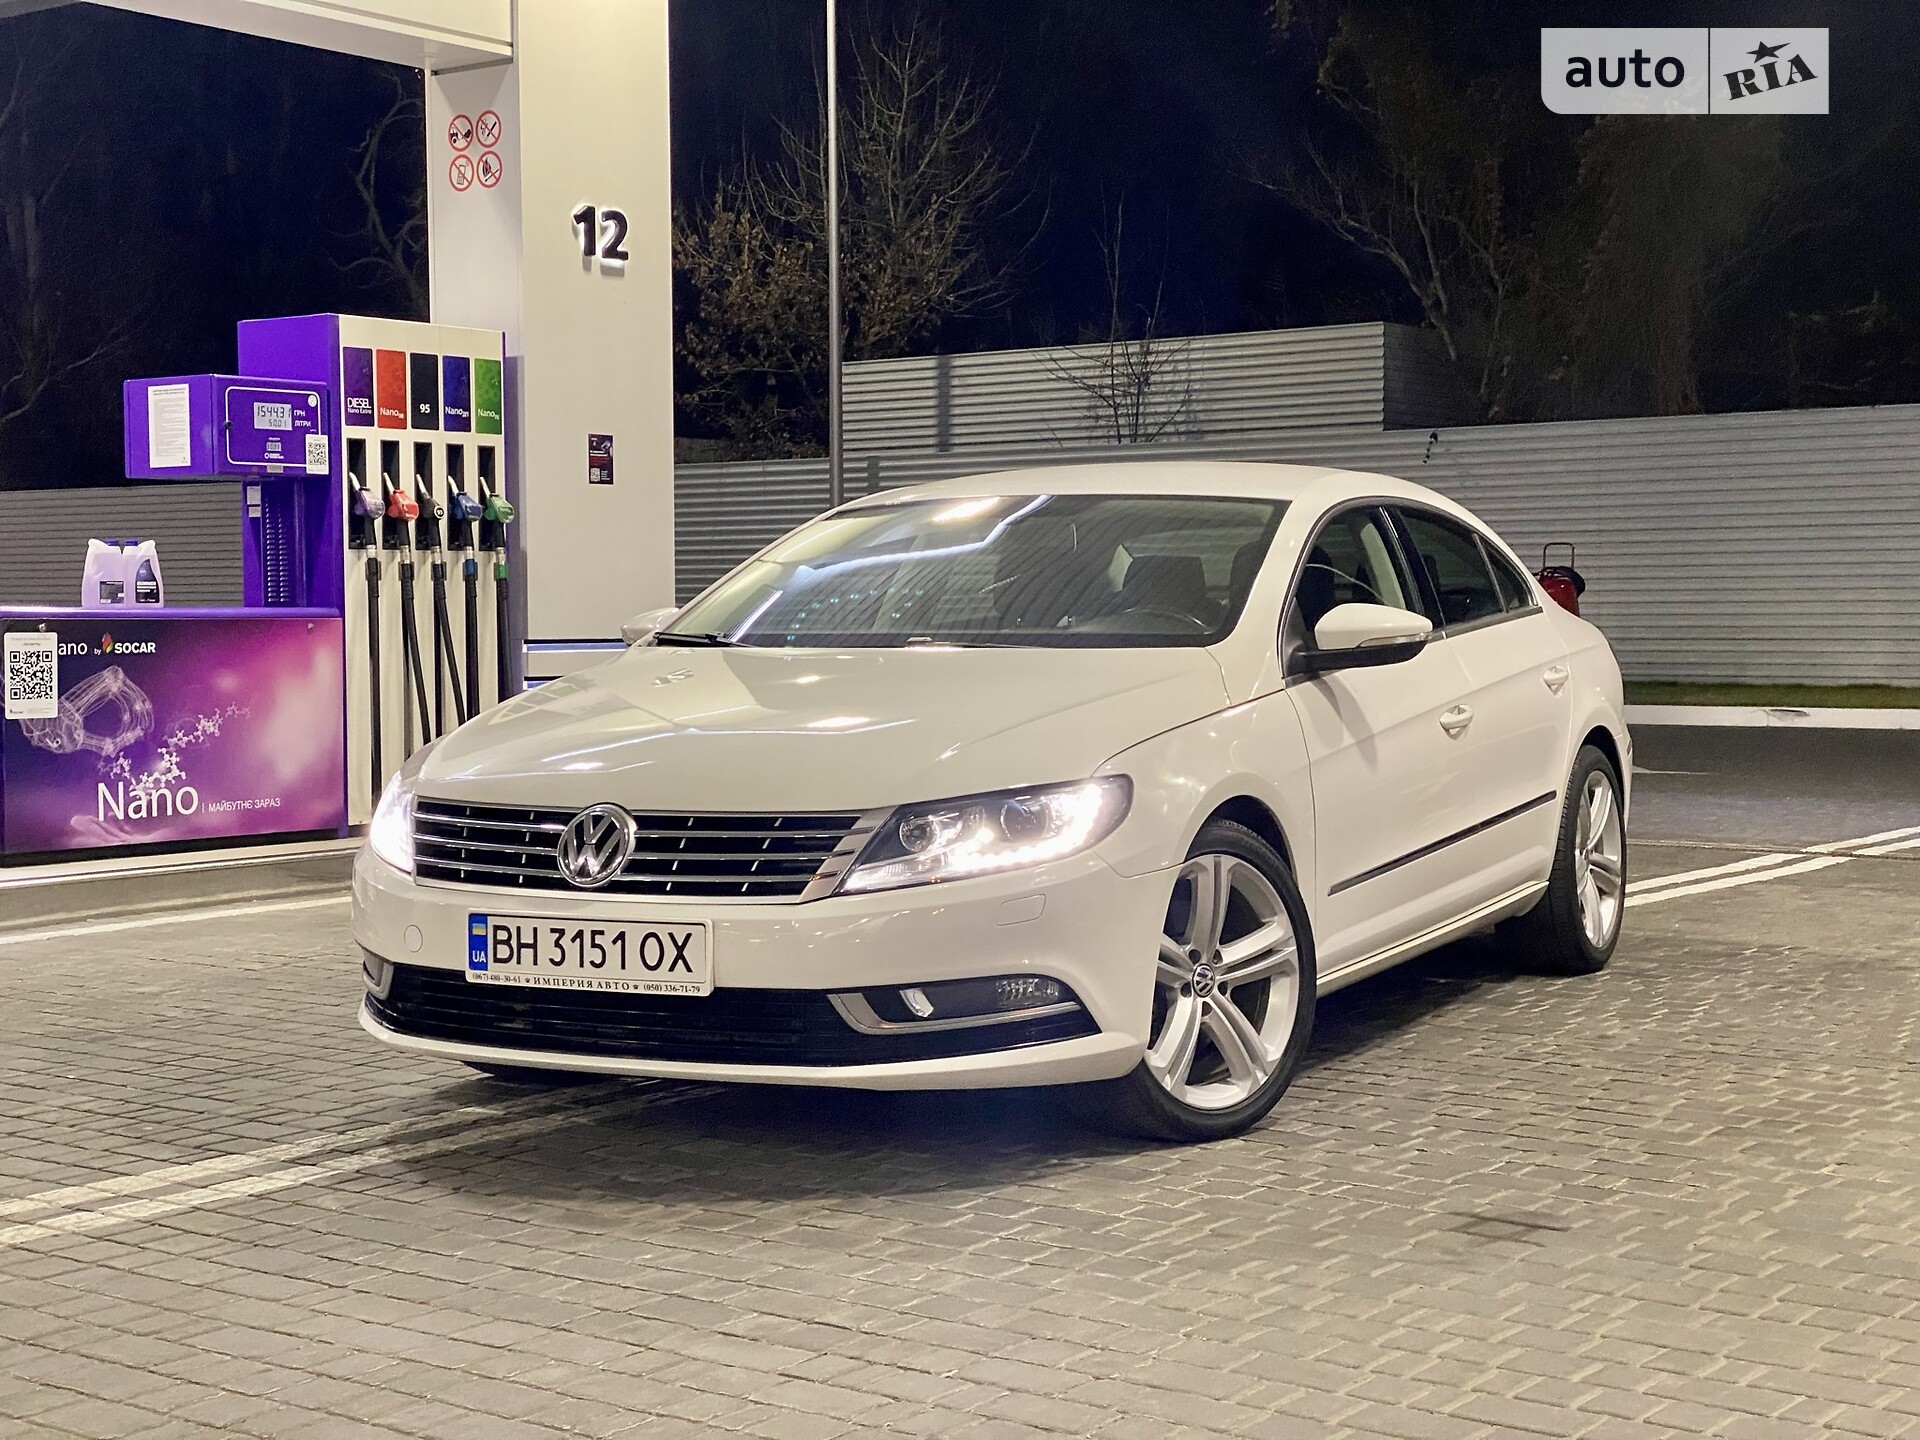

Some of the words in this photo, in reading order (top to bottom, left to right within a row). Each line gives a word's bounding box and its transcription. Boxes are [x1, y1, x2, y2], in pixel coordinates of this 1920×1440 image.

[573, 205, 629, 261] 12
[347, 398, 372, 409] DIESEL
[419, 404, 431, 414] 95
[58, 642, 87, 655] ano
[94, 647, 102, 656] by
[114, 642, 156, 654] SOCAR
[97, 781, 199, 821] Nano
[208, 800, 252, 813] МАЙБУТНЄ
[254, 797, 281, 809] ЗАРАЗ
[472, 950, 487, 962] UA
[492, 924, 538, 966] BH
[549, 927, 626, 970] 3151
[639, 931, 693, 973] OX
[472, 972, 489, 982] (067)
[533, 977, 593, 988] ИМПЕРИЯ
[597, 981, 630, 991] АВТО
[643, 982, 662, 993] (050)
[664, 984, 701, 994] 336-71-79
